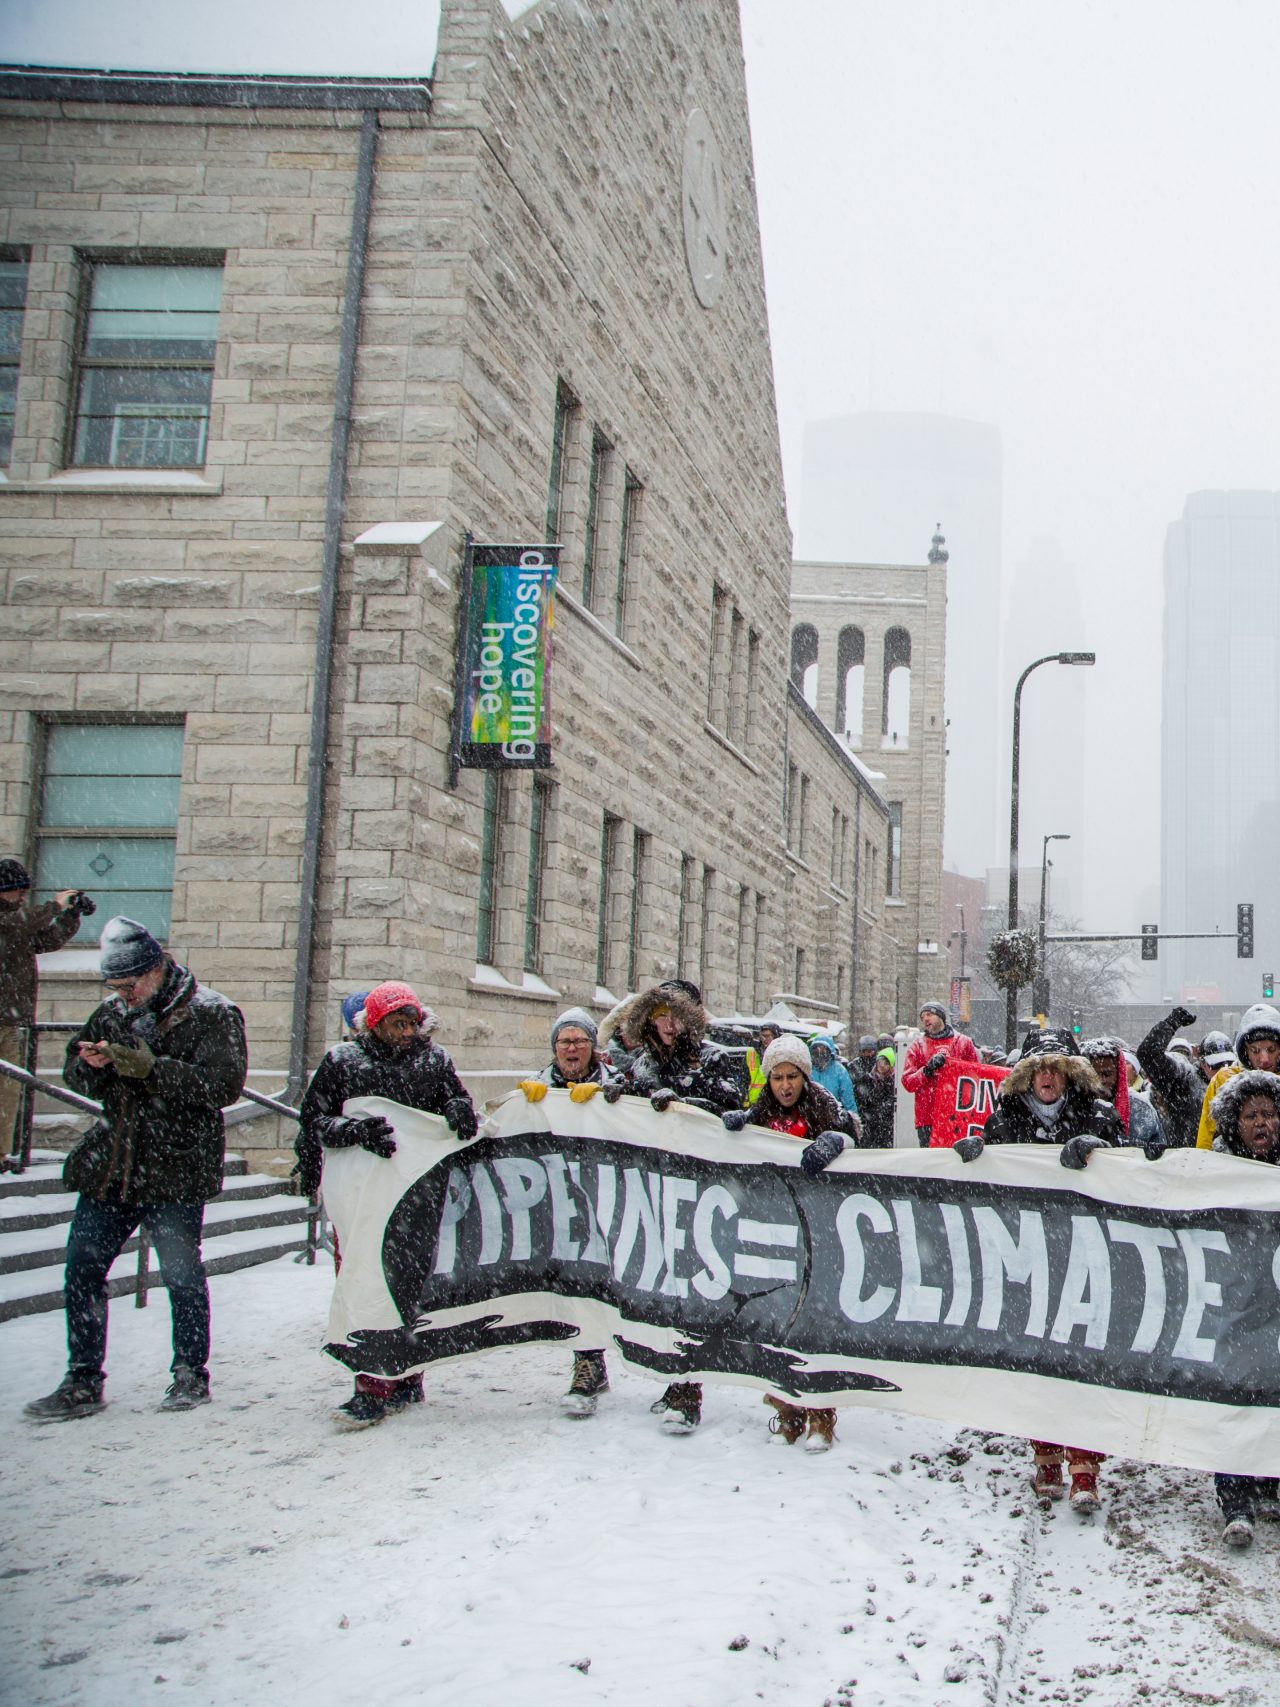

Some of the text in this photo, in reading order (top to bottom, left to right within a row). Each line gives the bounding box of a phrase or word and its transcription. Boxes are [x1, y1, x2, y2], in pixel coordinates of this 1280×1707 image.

[472, 622, 514, 715] hope
[502, 550, 551, 760] discovering
[835, 1193, 1231, 1362] CLIMATE
